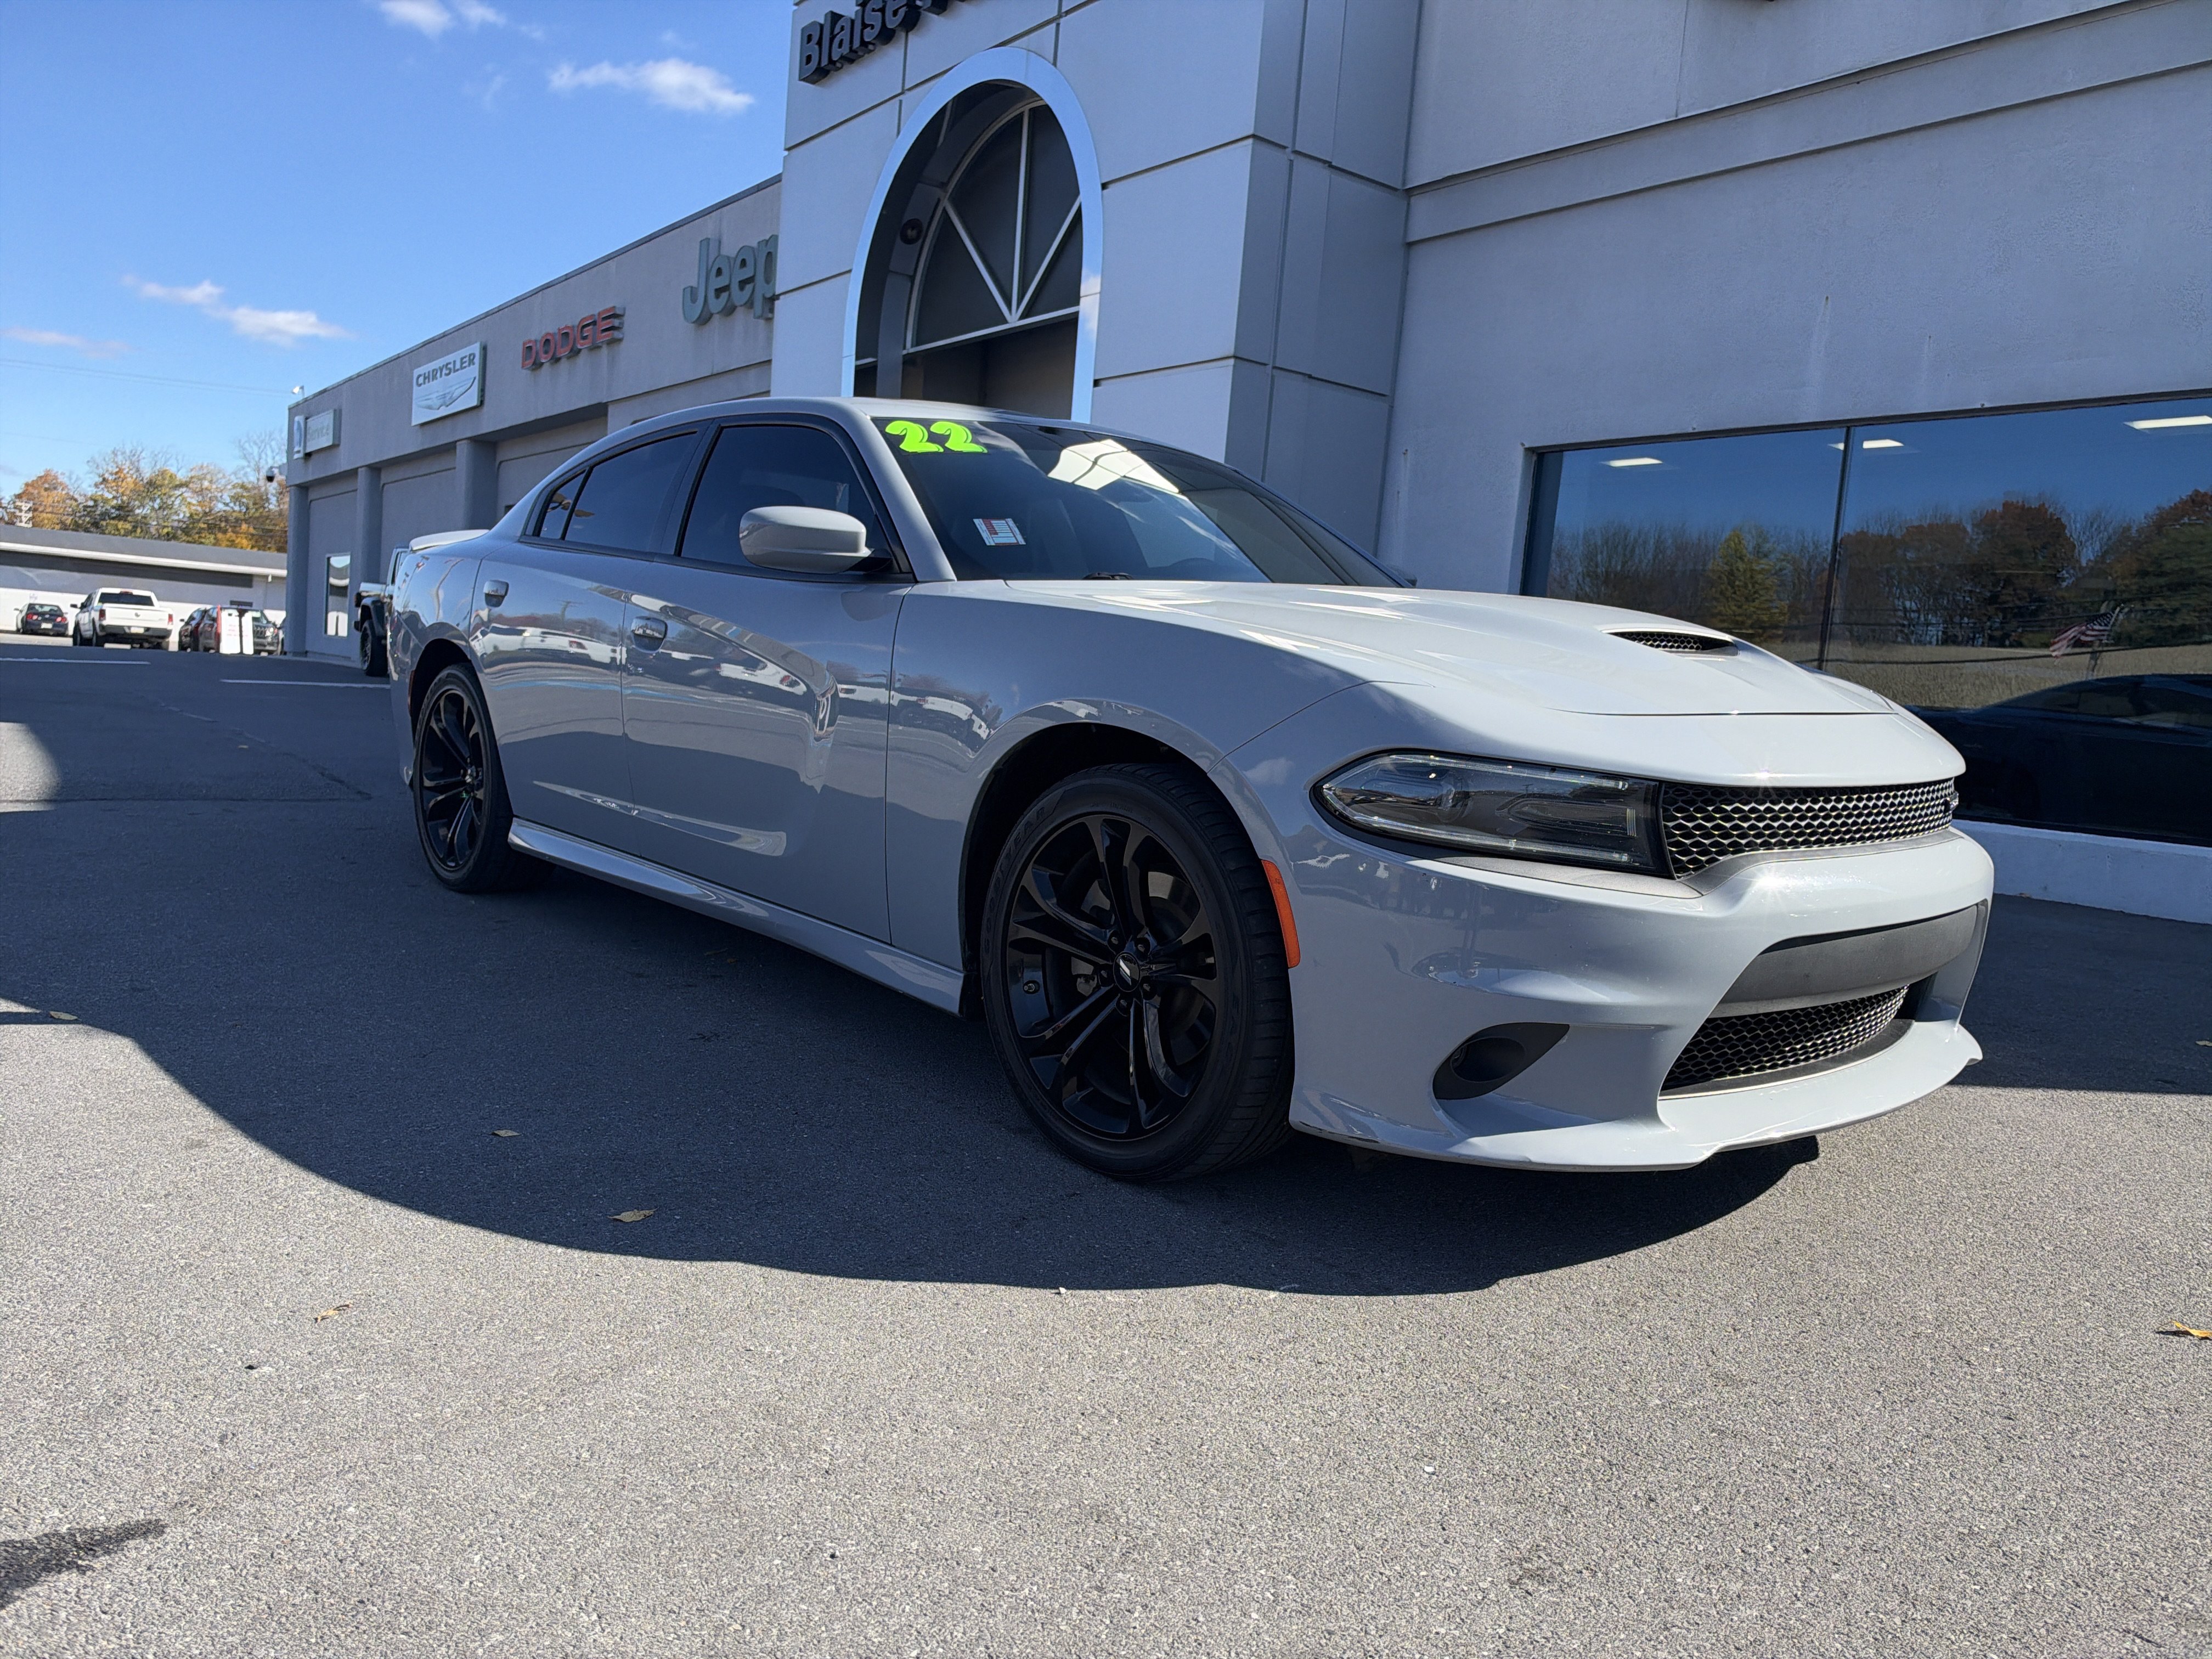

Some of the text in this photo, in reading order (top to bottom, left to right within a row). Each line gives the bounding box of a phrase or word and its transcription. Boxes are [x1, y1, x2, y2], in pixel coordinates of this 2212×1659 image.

[799, 0, 912, 82] Blaise
[682, 235, 778, 324] Jeep
[522, 306, 623, 369] DODGE
[416, 353, 476, 387] CHRYSLER
[885, 420, 988, 453] 22
